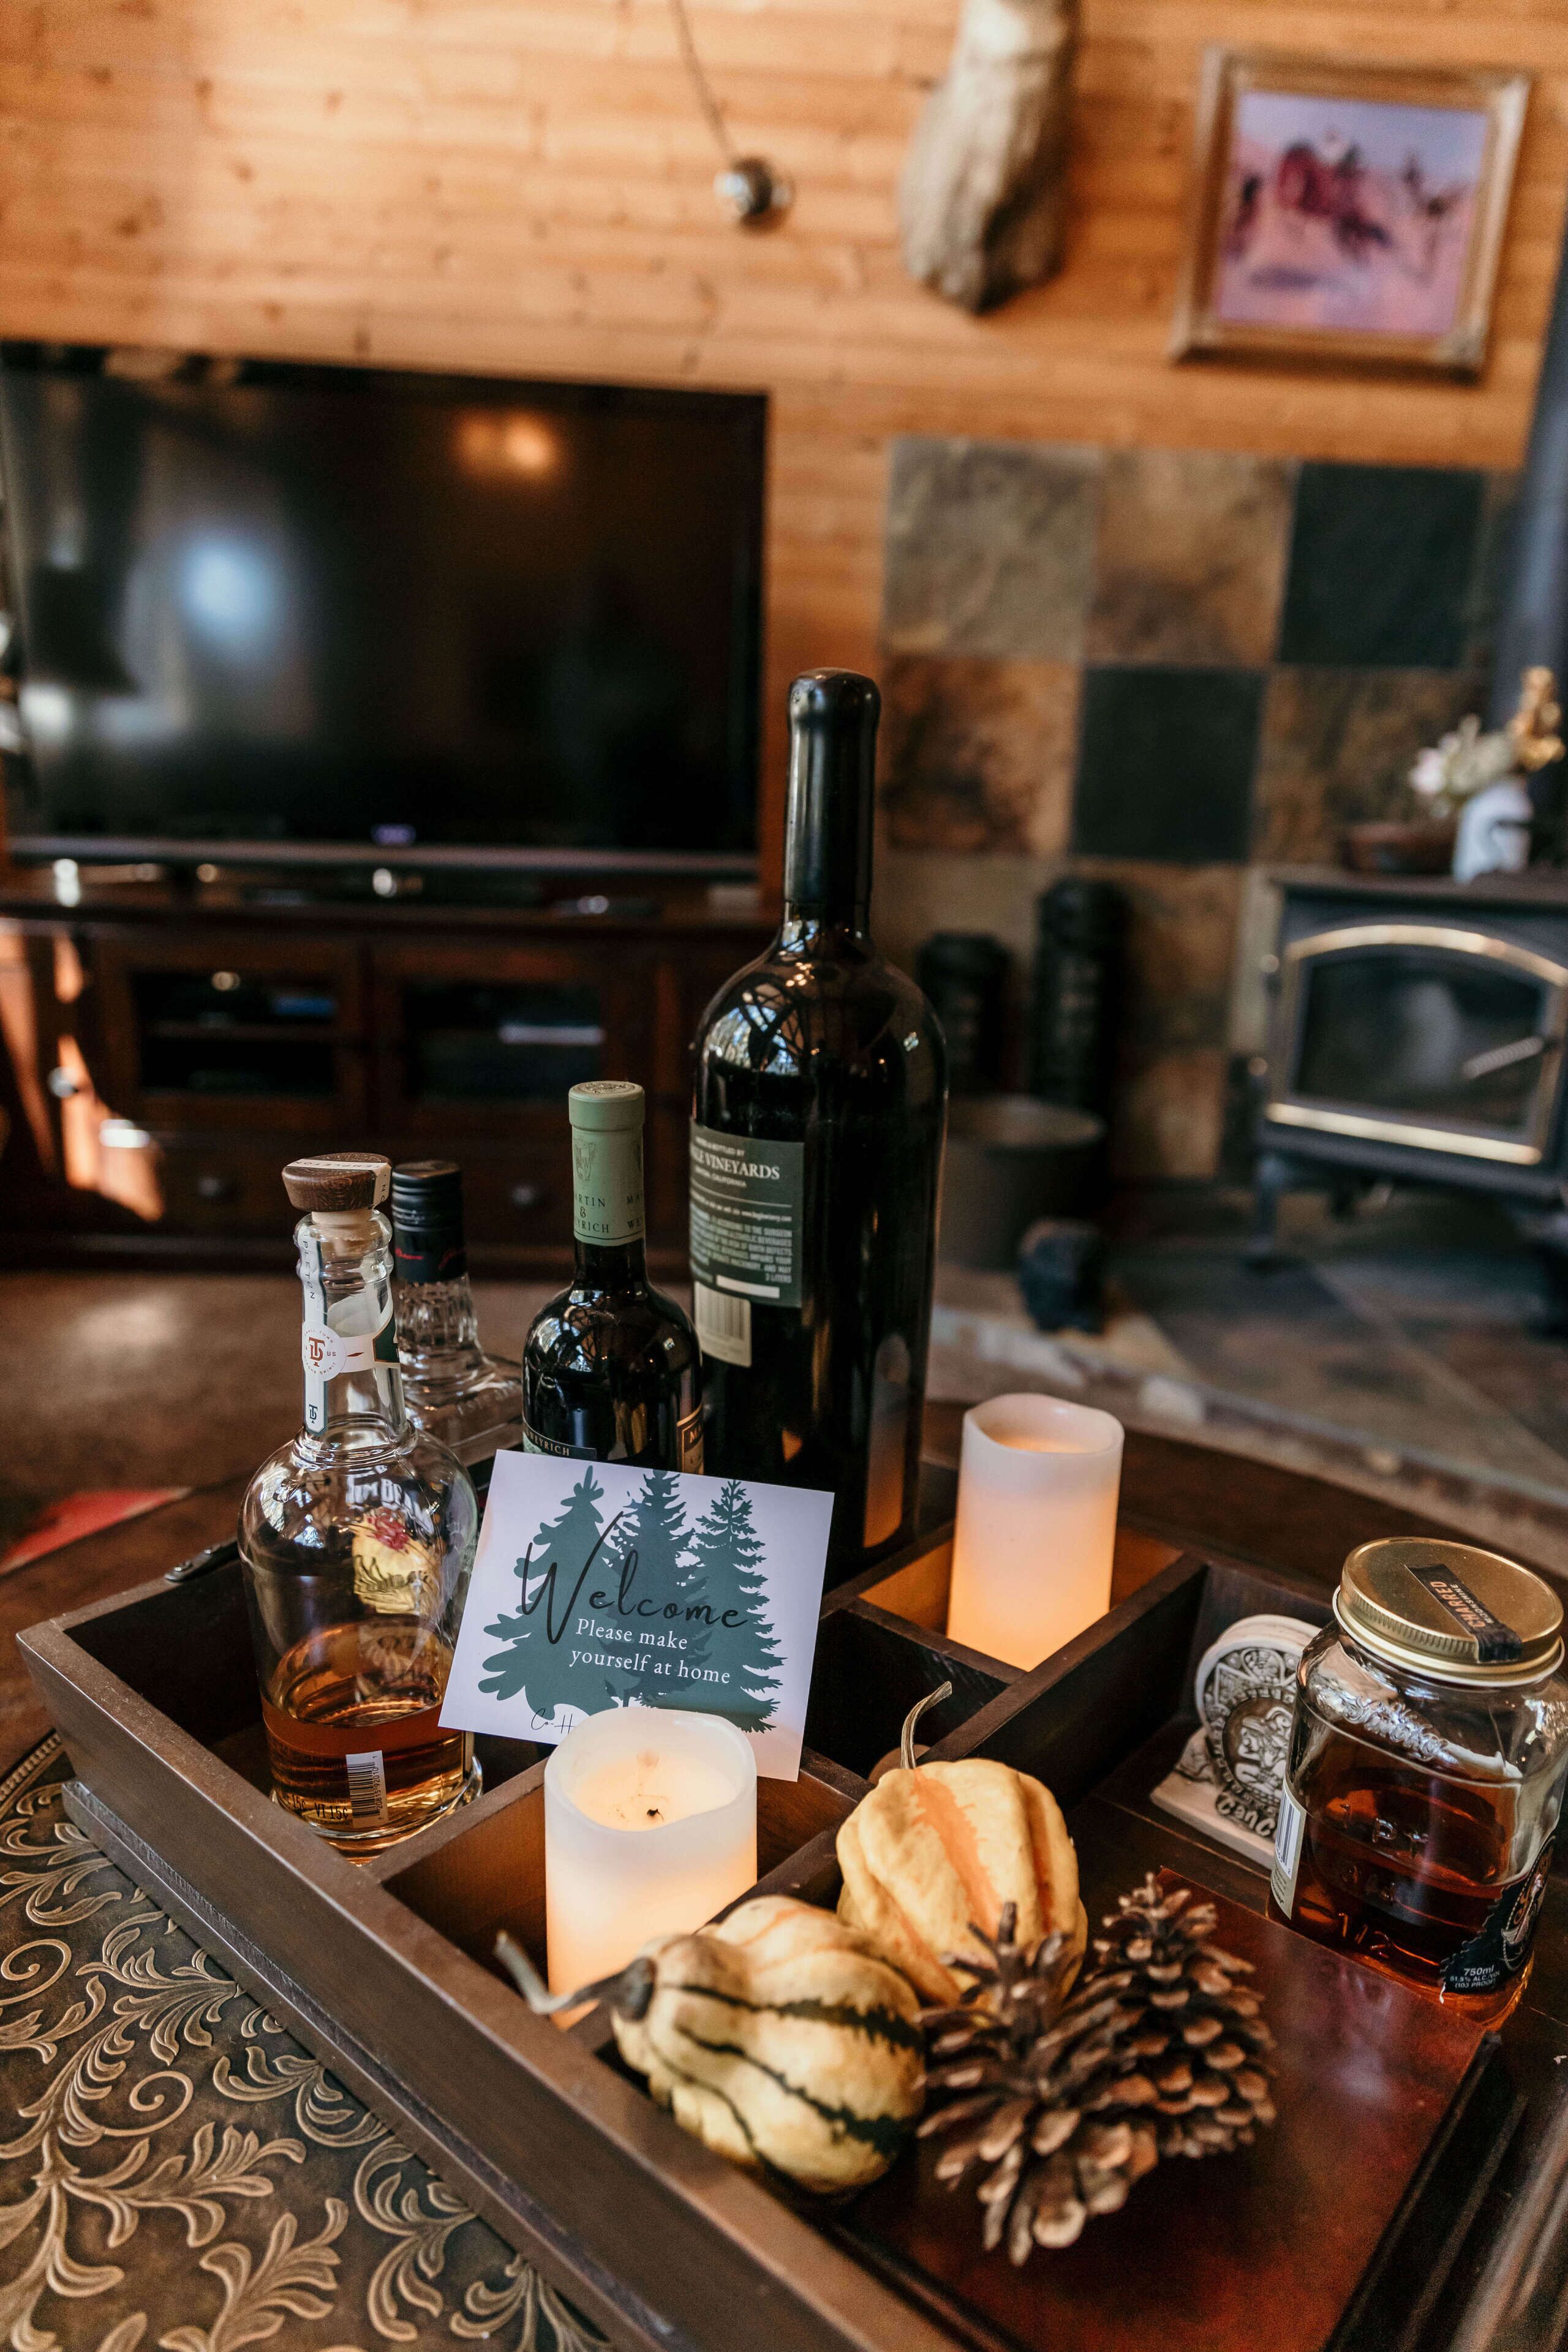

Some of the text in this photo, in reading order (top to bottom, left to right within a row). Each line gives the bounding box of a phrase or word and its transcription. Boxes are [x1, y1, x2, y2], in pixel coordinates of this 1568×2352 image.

[704, 1152, 780, 1180] VINEYARDS
[580, 1205, 586, 1218] &
[522, 1510, 748, 1645] Welcome
[1431, 1581, 1486, 1627] CHARRED
[1450, 1583, 1494, 1624] MOONSHINE
[576, 1618, 688, 1650] Please make
[568, 1650, 731, 1684] yourself at home
[531, 1708, 576, 1735] Co-H
[314, 1802, 326, 1819] VT
[1464, 1965, 1494, 1977] 750ml
